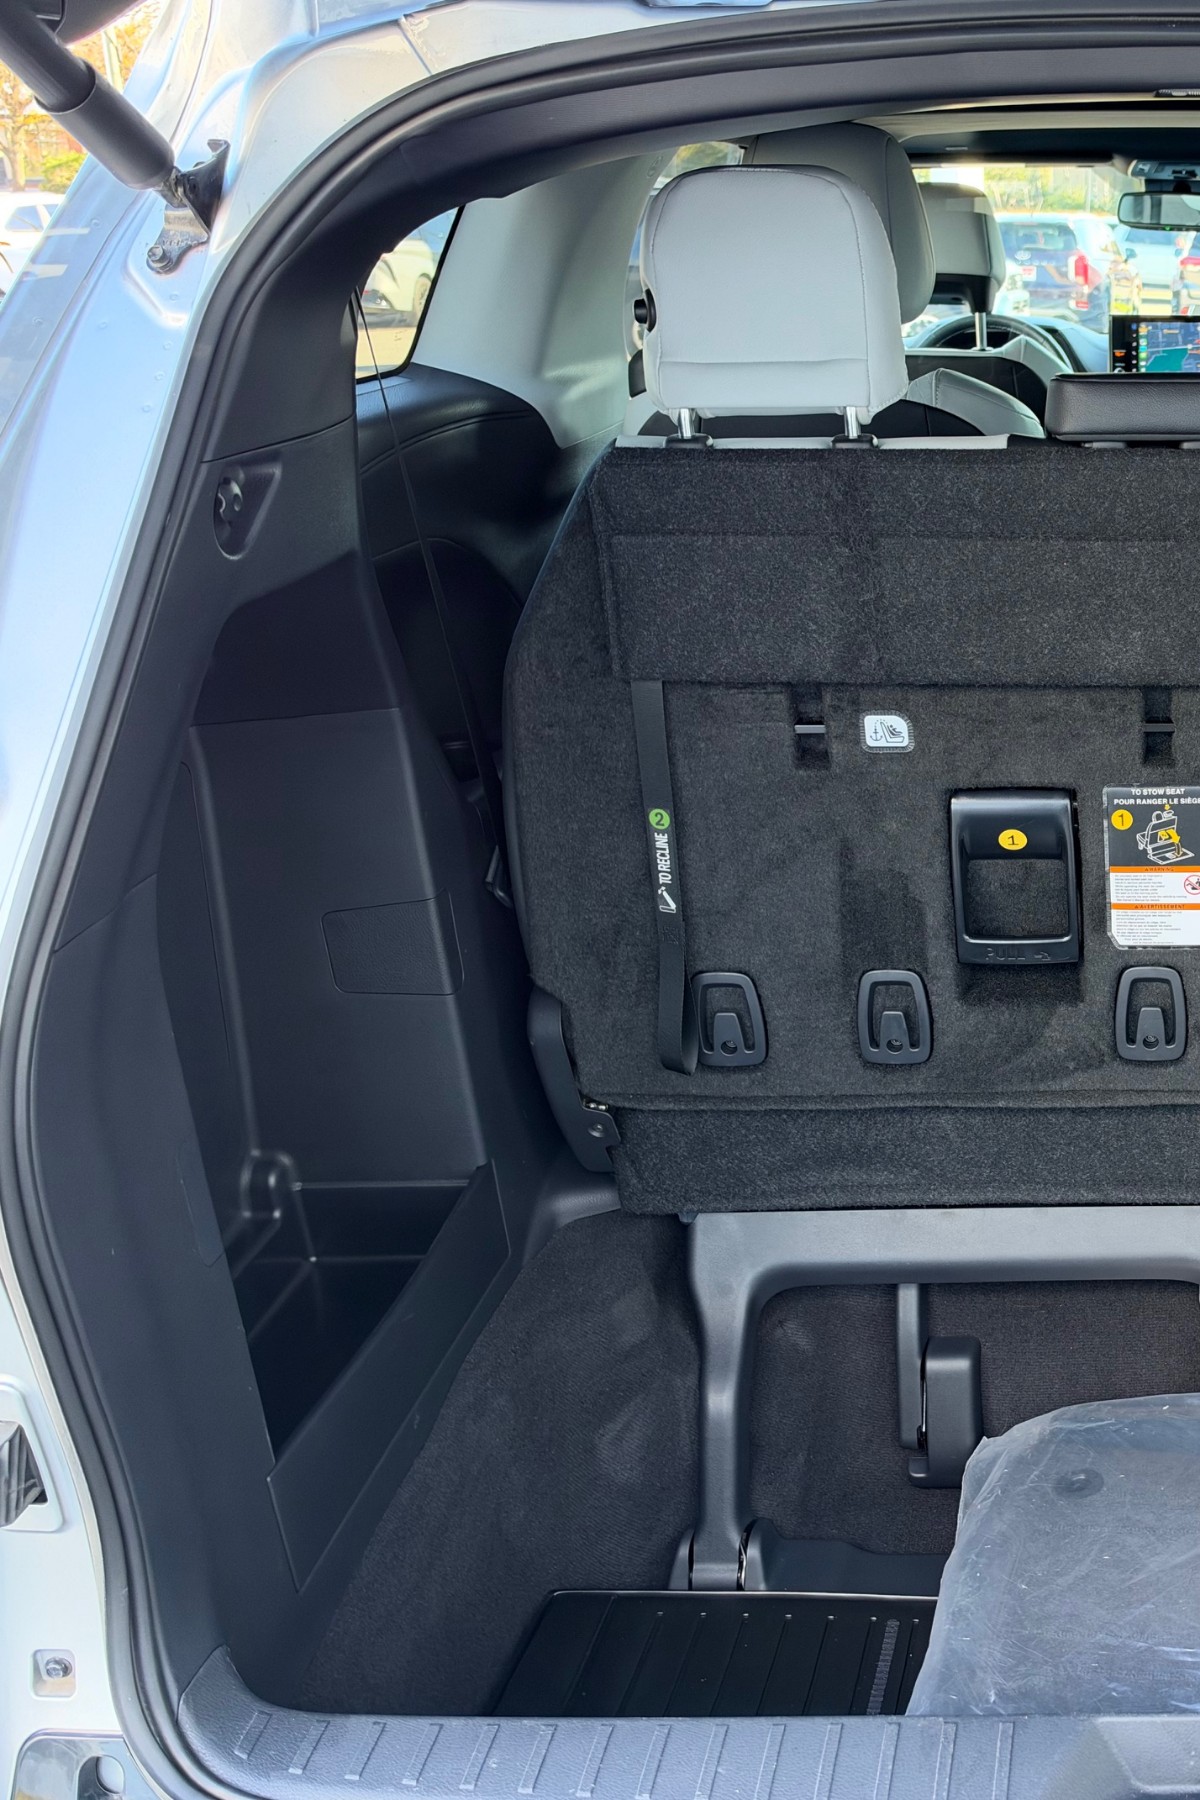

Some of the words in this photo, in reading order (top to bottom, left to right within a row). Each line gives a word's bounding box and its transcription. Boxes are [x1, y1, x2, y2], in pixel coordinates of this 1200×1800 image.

[654, 811, 665, 827] 2
[1118, 812, 1125, 827] 1
[1007, 835, 1019, 846] 1
[654, 832, 671, 872] RECLINE
[659, 872, 672, 884] TO
